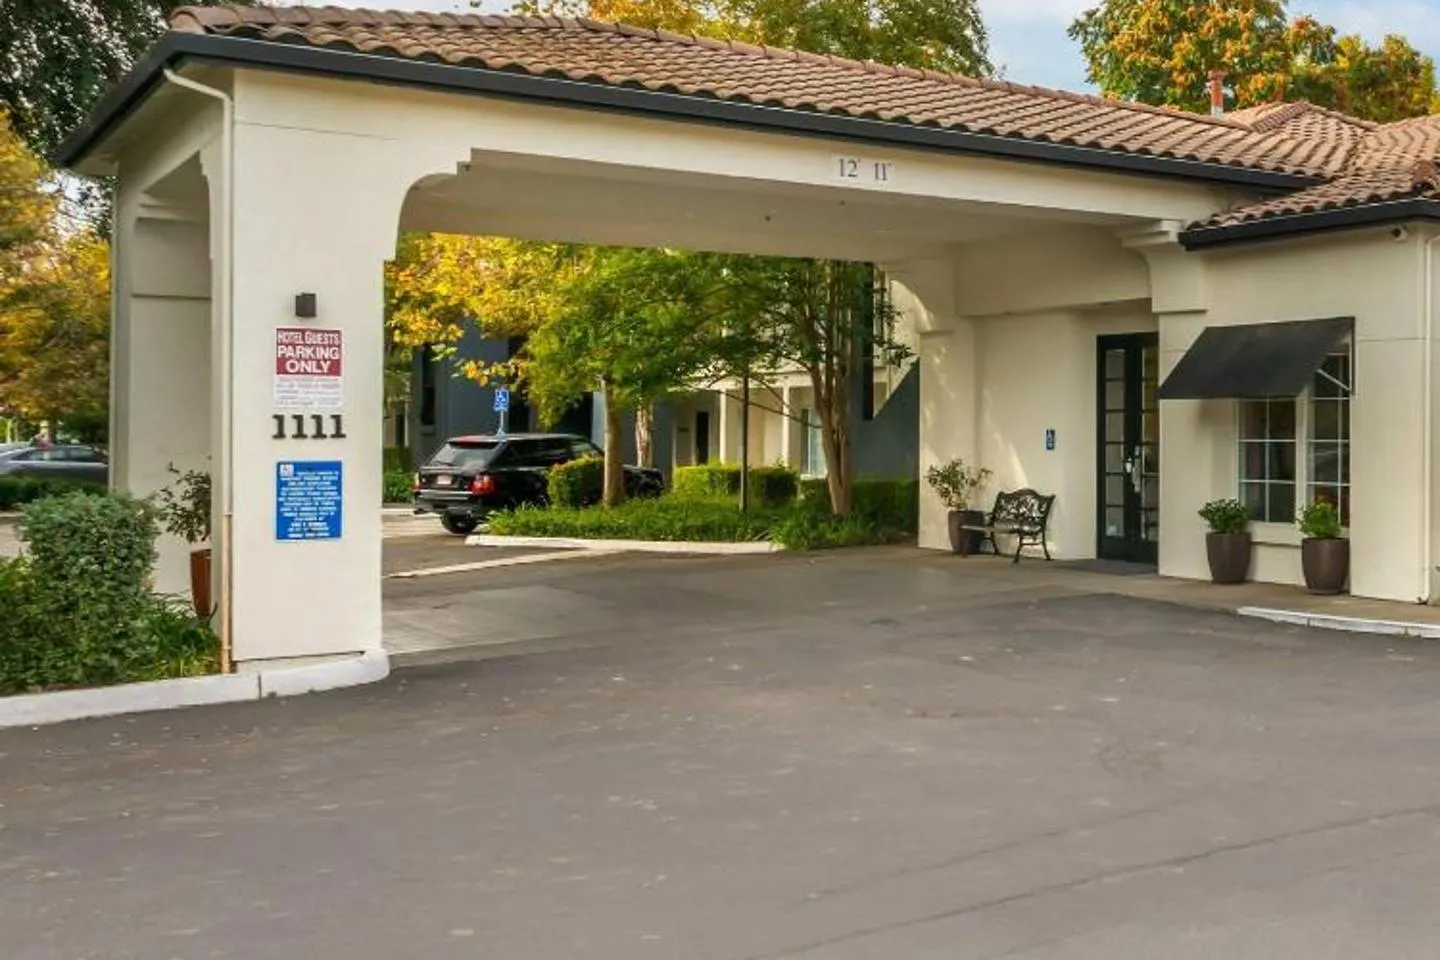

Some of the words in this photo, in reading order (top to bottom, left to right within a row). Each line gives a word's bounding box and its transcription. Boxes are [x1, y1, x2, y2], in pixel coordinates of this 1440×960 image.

[277, 345, 340, 359] PARKING
[285, 360, 331, 373] ONLY
[271, 414, 346, 439] 1111
